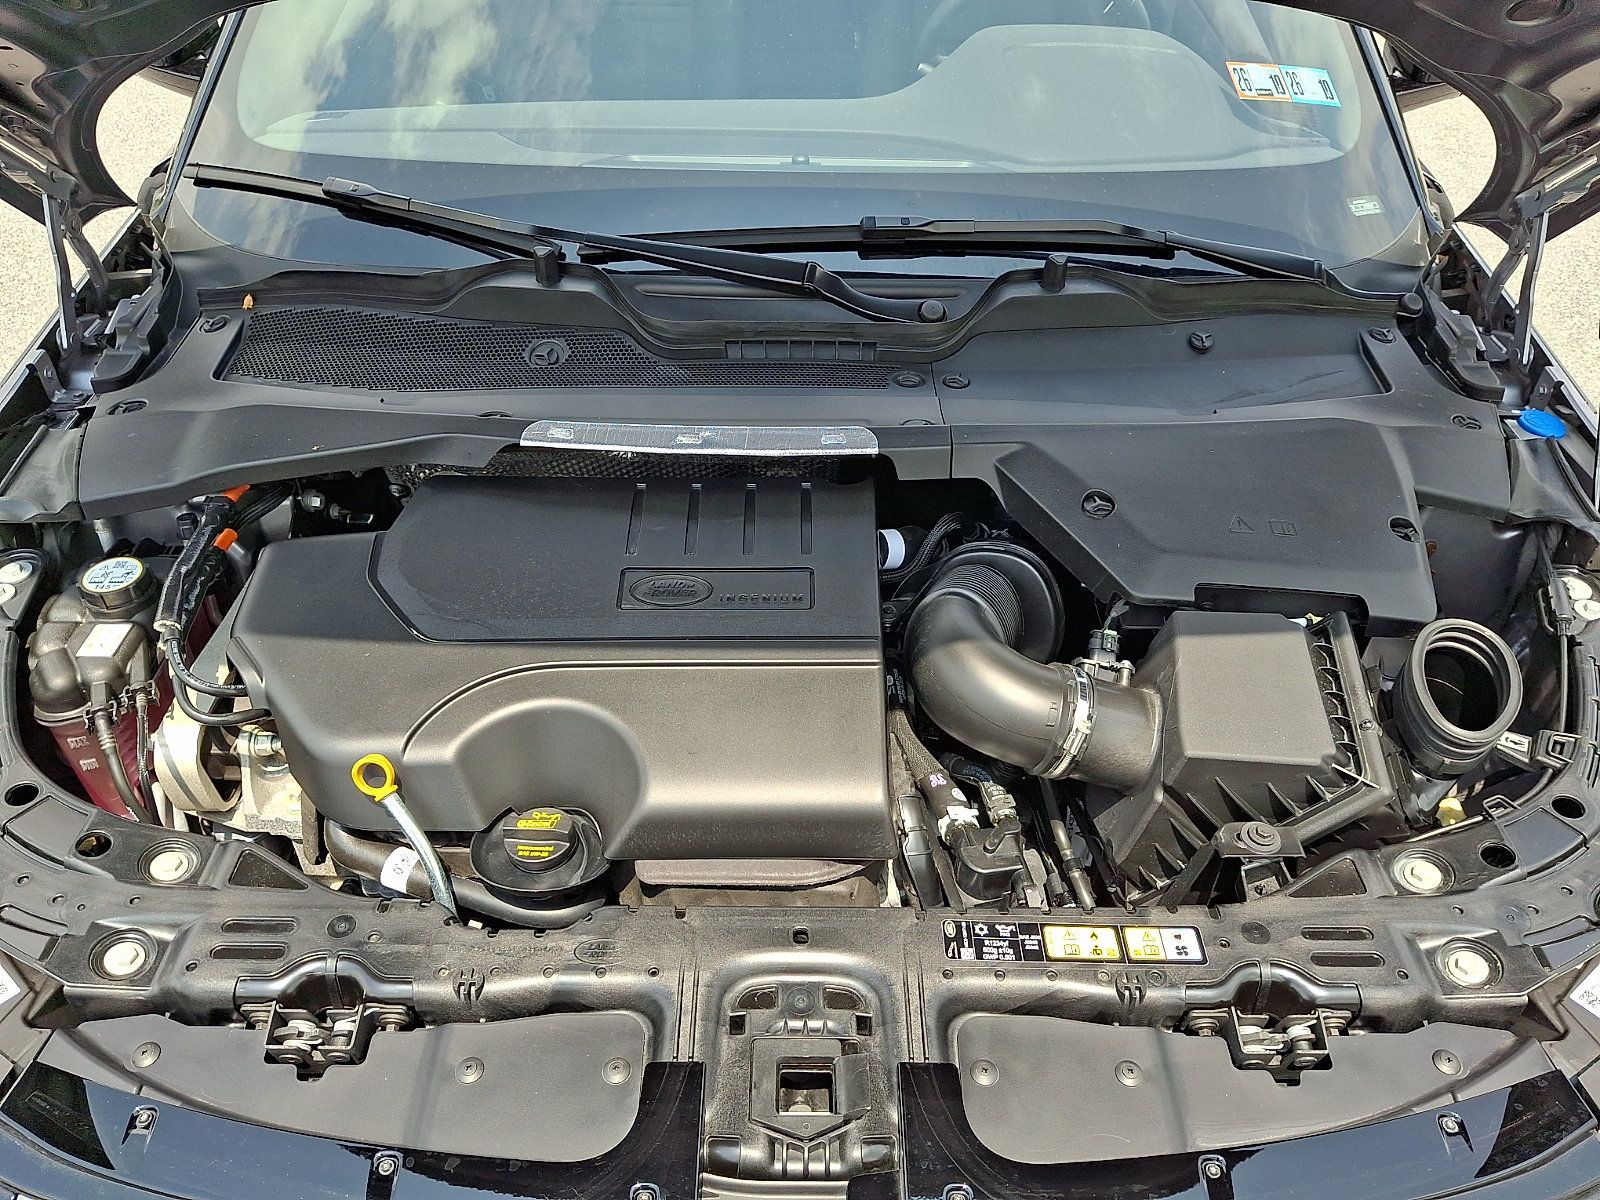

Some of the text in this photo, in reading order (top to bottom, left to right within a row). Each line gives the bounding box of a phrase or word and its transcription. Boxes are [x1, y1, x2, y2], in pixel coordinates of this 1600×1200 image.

[1233, 67, 1253, 92] 26
[1285, 71, 1304, 96] 26
[719, 593, 805, 603] INGENIUM
